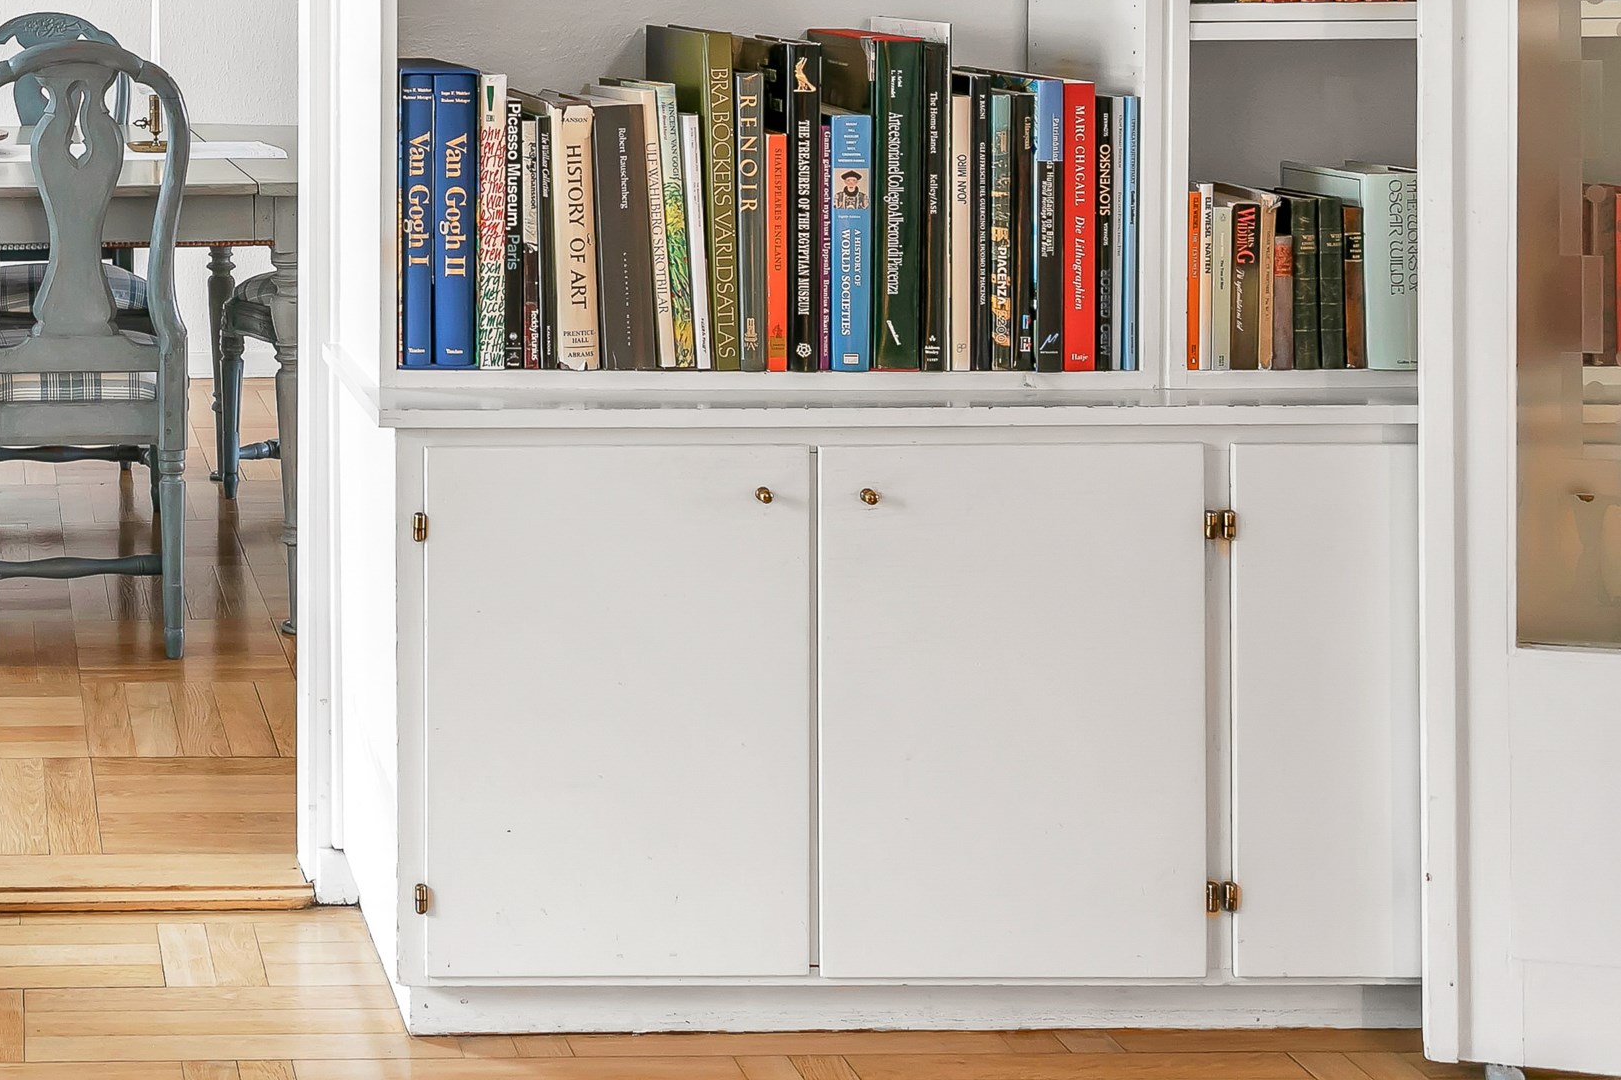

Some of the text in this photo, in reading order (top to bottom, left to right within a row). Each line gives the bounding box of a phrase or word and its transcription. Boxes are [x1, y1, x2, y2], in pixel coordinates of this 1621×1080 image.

[404, 132, 430, 266] Van Gogh I
[440, 133, 467, 278] Van Gogh II
[507, 103, 522, 270] Picasso Museum, Paris
[620, 155, 629, 209] Rauschenberg
[711, 67, 737, 360] BRA BÖCKERS VÄRLDSATLAS
[739, 93, 760, 213] RENOIR
[930, 92, 938, 216] The Home Planet Kelley/ASE
[1072, 106, 1086, 311] MARC CHAGALL Die Lithographien
[1100, 145, 1110, 216] SLOVENSKO
[567, 145, 587, 310] HISTORY OF ART
[646, 142, 669, 315] ULF WAHLBERG SKROTBILAR
[774, 223, 782, 272] ENGLAND
[798, 120, 810, 315] THE TREASURES OF THE EGYPTIAN MUSEUM
[997, 246, 1008, 307] PIACENZA
[1389, 179, 1405, 296] OSCAR WILDE
[841, 229, 851, 337] WORLD SOCIETIES
[1072, 354, 1089, 362] Hatje
